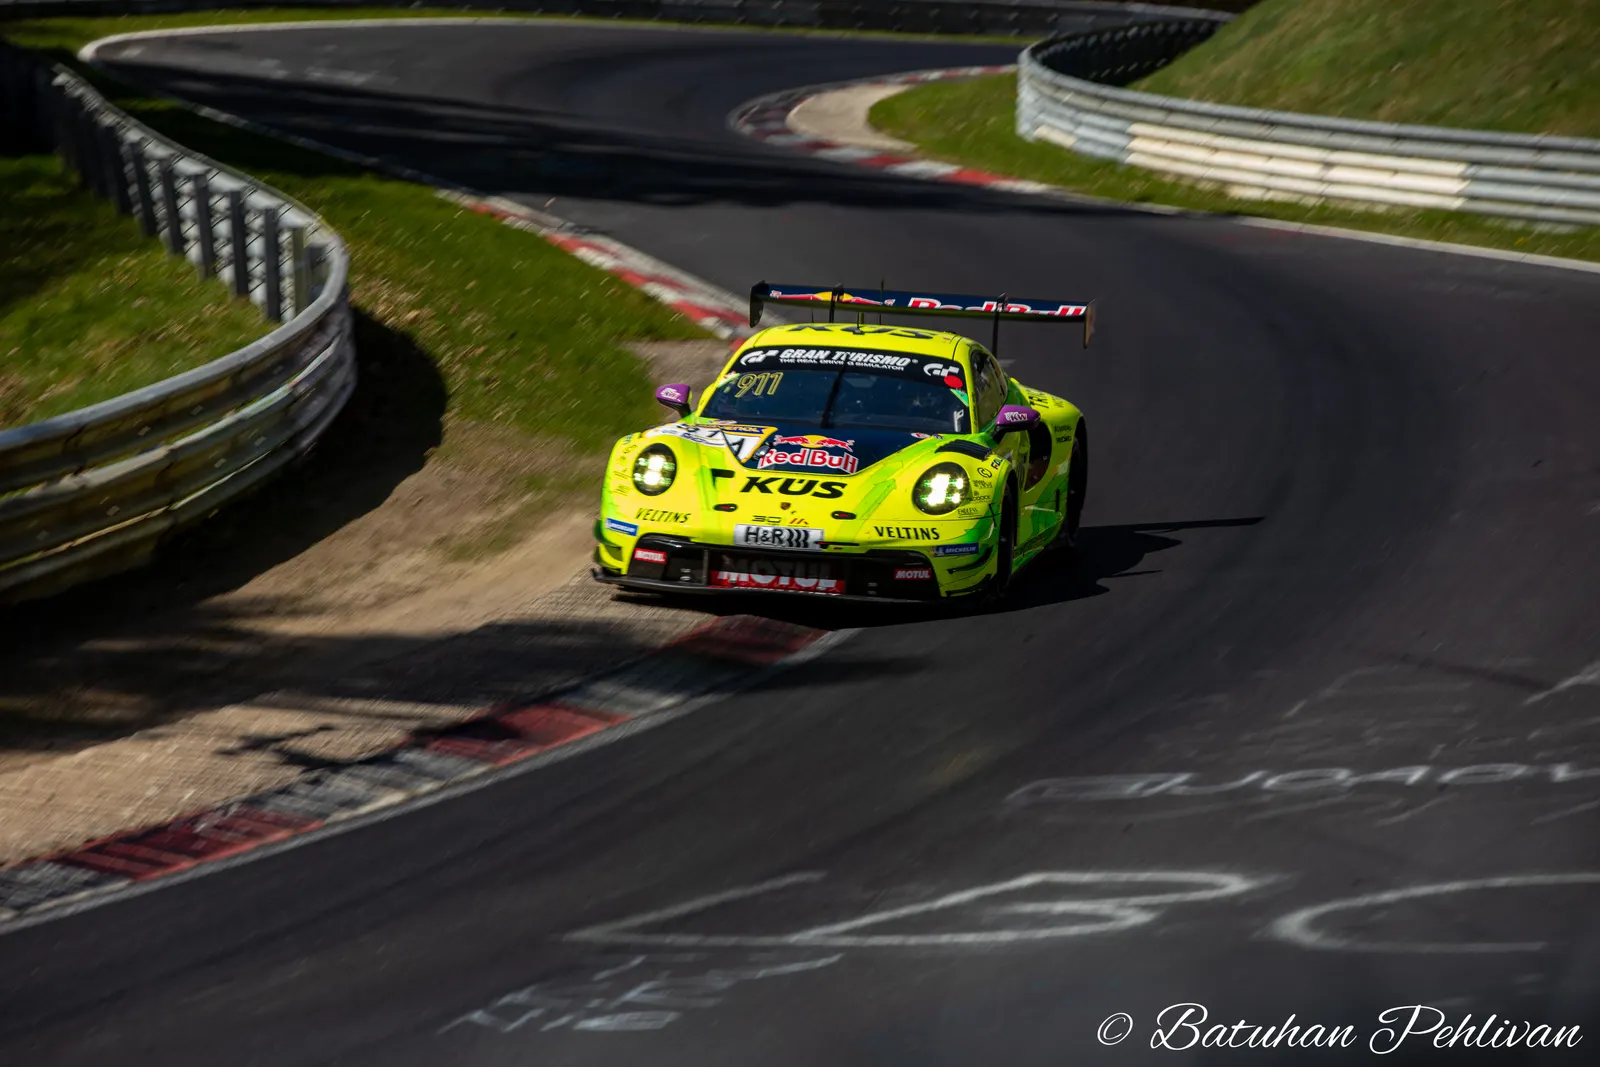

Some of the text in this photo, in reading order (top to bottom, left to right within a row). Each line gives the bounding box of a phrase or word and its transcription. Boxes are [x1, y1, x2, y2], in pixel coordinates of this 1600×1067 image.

[779, 349, 912, 367] GRAN TURISMO
[855, 361, 904, 371] SIMULATOR
[734, 372, 784, 398] 911
[757, 448, 859, 475] Red Bull
[635, 507, 692, 524] VELTINS
[744, 526, 784, 544] H&R
[873, 525, 940, 541] VELTINS
[944, 546, 977, 554] MICHELIN
[717, 555, 837, 590] MOTUL
[895, 570, 930, 579] MOTUL
